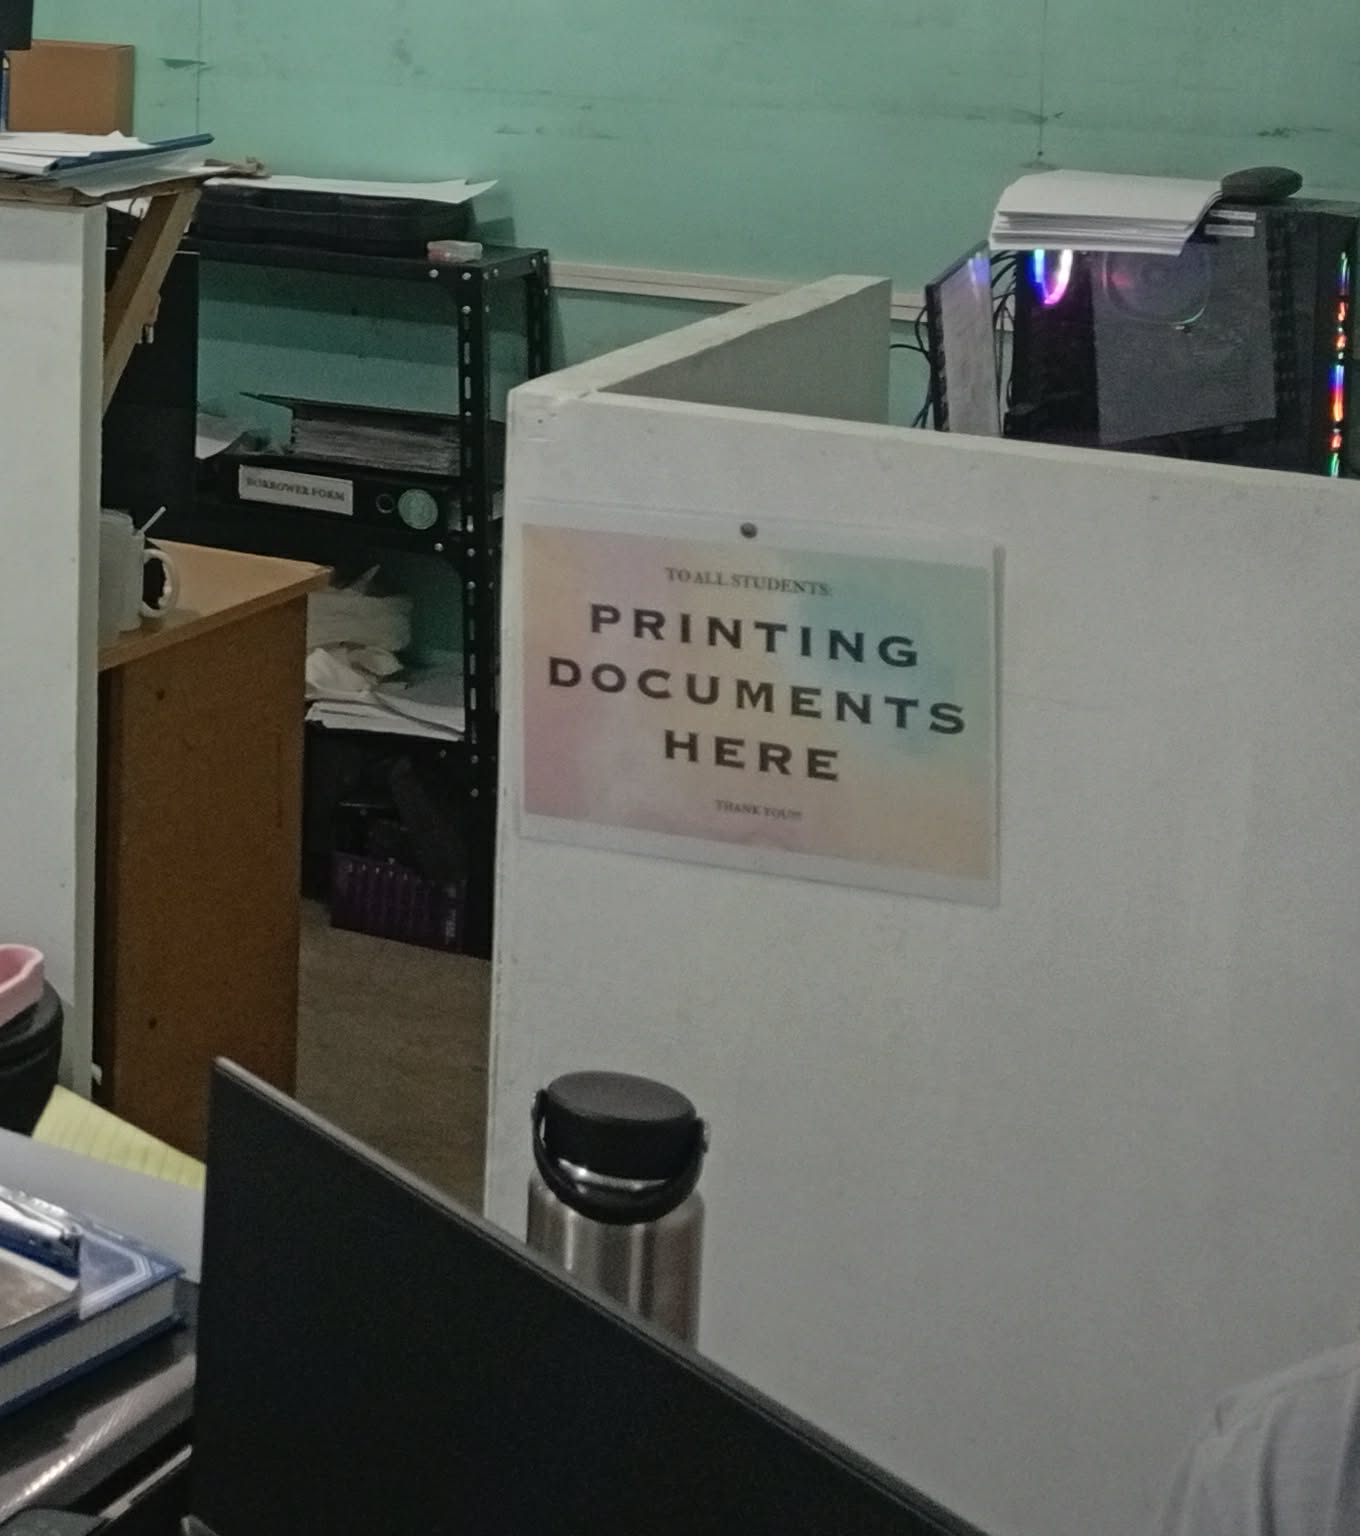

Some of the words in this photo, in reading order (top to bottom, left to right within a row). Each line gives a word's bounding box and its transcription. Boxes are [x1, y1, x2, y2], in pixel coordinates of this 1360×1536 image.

[311, 486, 345, 502] FORM
[665, 567, 692, 583] TO
[692, 570, 729, 586] ALL
[588, 602, 919, 668] PRINTING
[548, 656, 967, 736] DOCUMENTS
[663, 729, 841, 782] HERE
[714, 799, 760, 815] THANK
